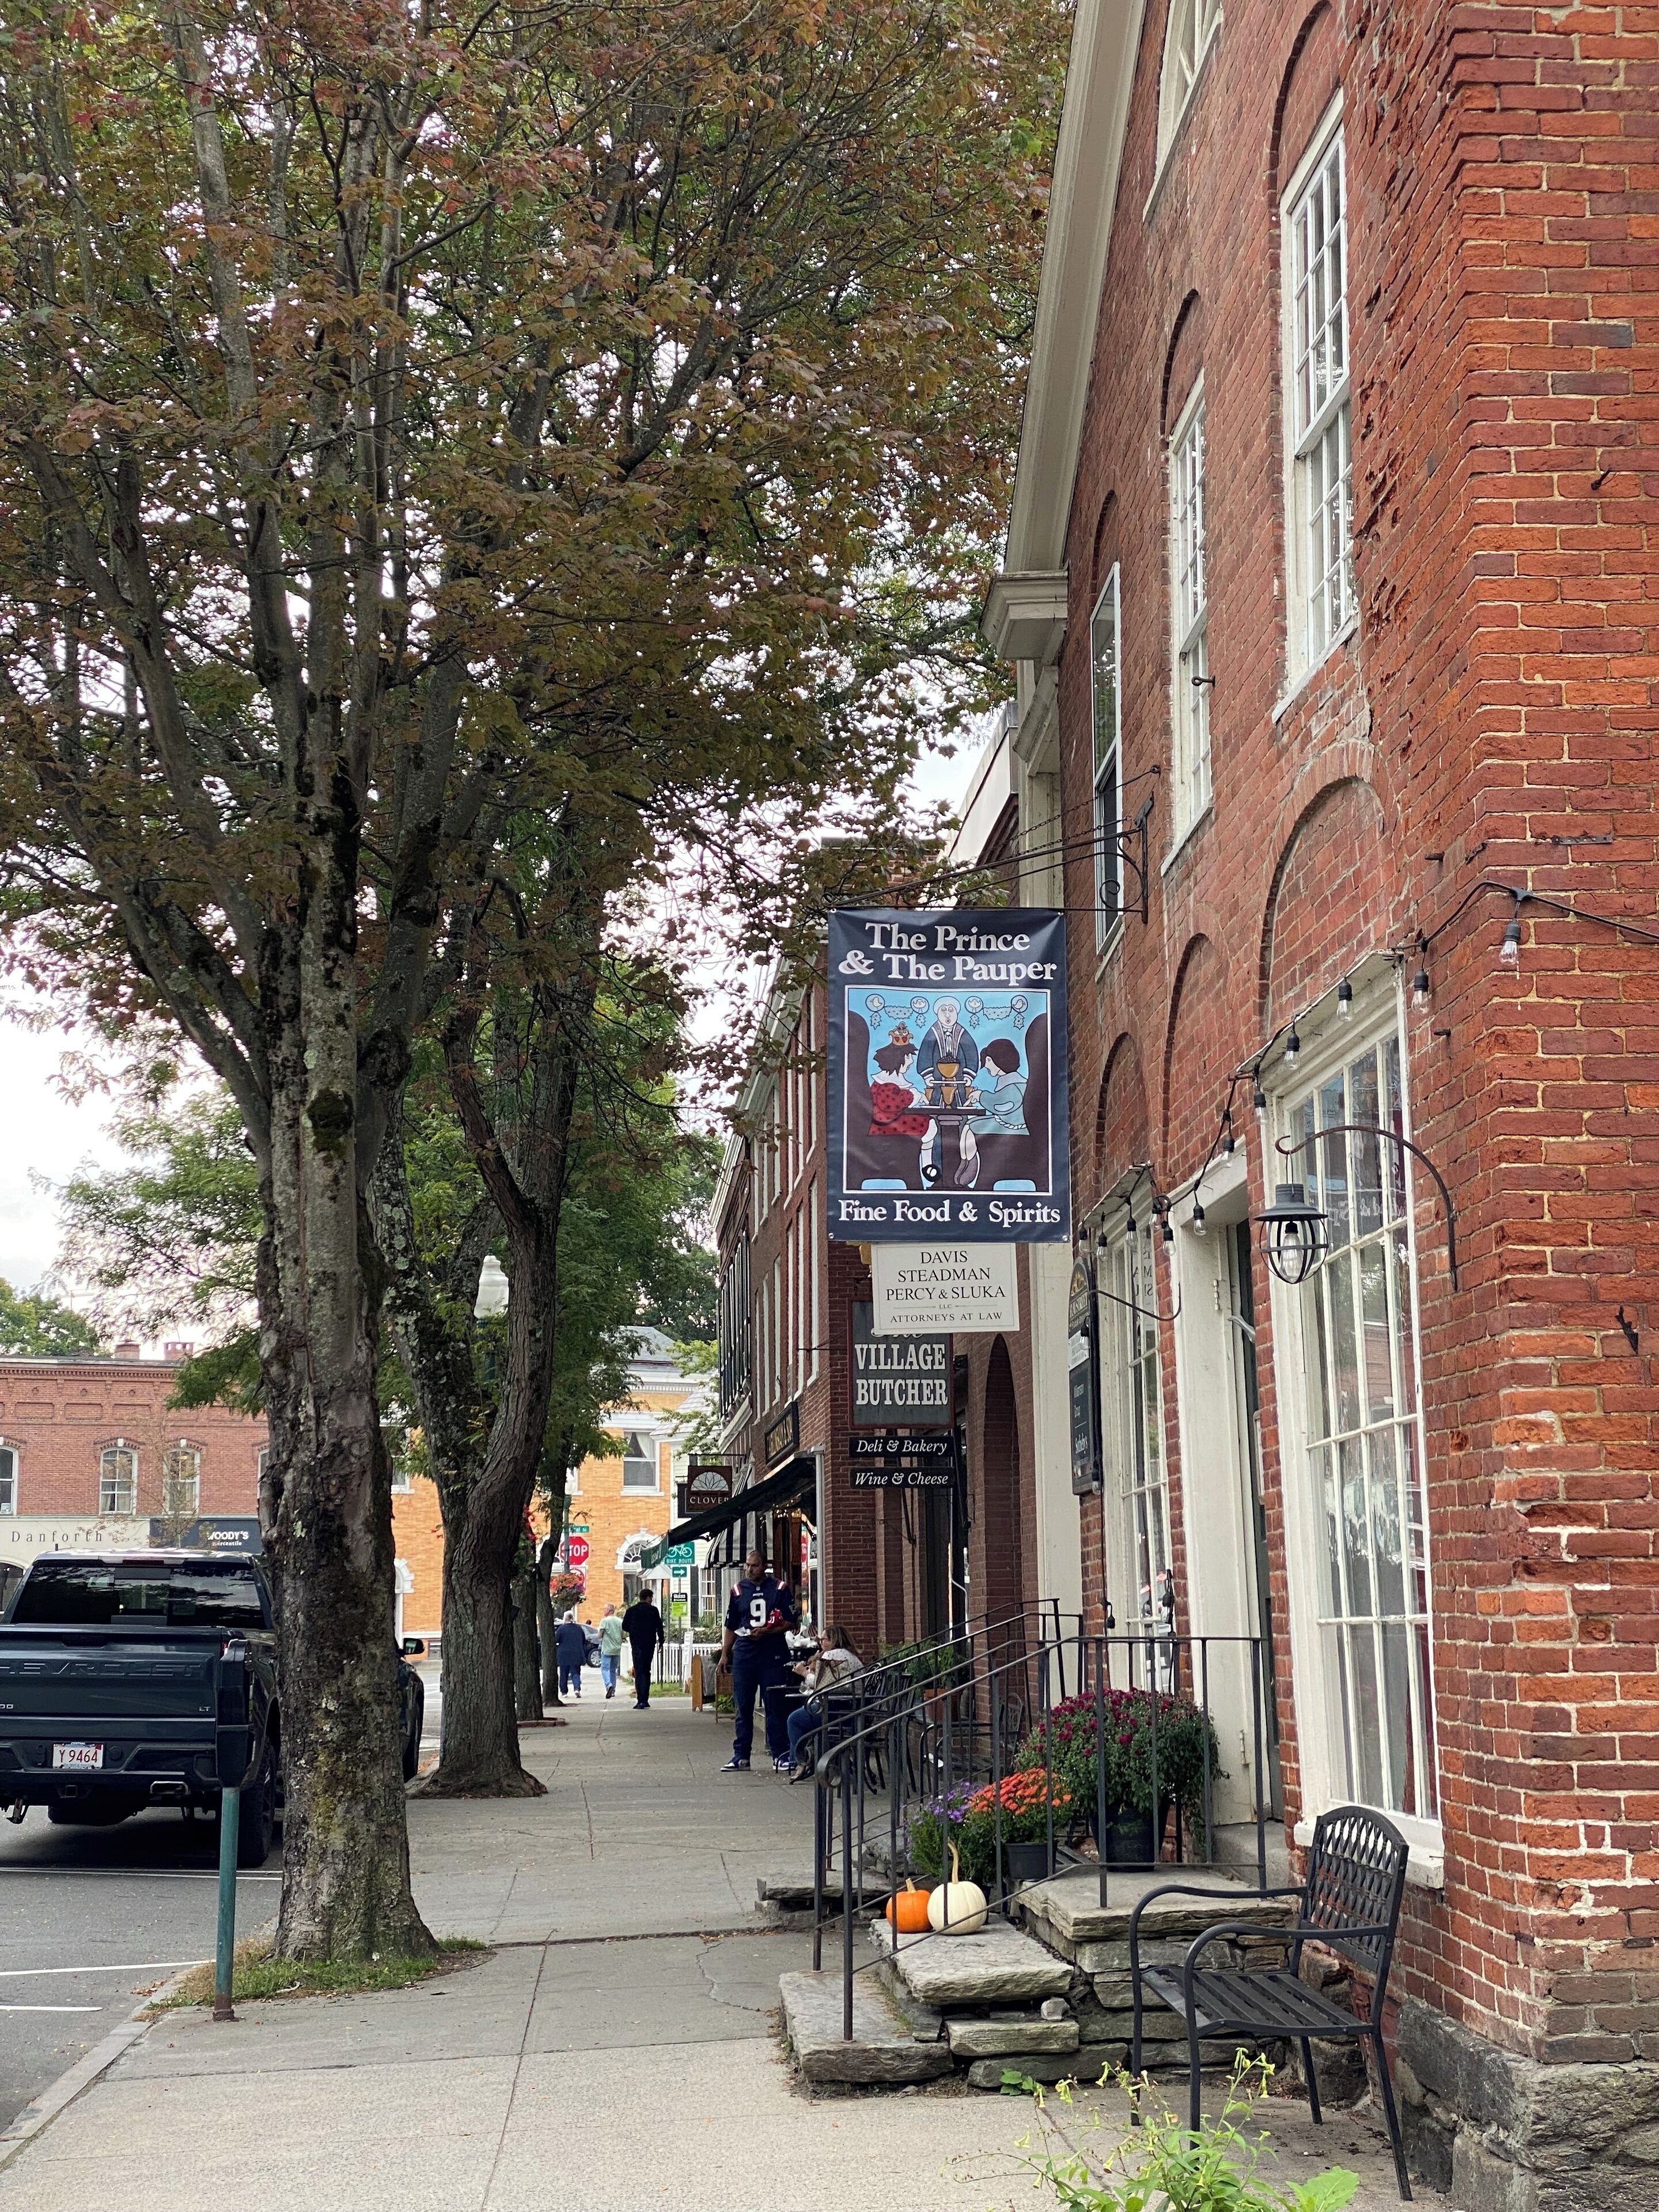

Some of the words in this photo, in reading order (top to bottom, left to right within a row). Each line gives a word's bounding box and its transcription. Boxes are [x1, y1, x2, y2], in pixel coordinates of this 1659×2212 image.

[865, 922, 926, 950] The
[934, 926, 1030, 952] Prince
[839, 950, 874, 975] &
[882, 953, 945, 980] The
[953, 956, 1058, 986] Pauper
[838, 1199, 887, 1222] Fine
[893, 1200, 950, 1222] Food
[959, 1202, 978, 1222] &
[988, 1202, 1060, 1228] Spirits
[921, 1250, 968, 1264] DAVIS
[897, 1267, 991, 1283] STEADMAN
[886, 1287, 935, 1301] PERCY
[938, 1289, 948, 1300] &
[951, 1286, 1006, 1299] SLUKA
[890, 1313, 955, 1323] ATTORNEYS
[960, 1312, 975, 1321] AT
[979, 1312, 1002, 1320] LAW
[854, 1343, 946, 1370] VILLAGE
[856, 1379, 948, 1406] BUTCHER
[857, 1440, 882, 1452] Deli
[887, 1440, 899, 1451] &
[903, 1440, 947, 1455] Bakery
[855, 1473, 888, 1486] Wine
[892, 1473, 904, 1484] &
[908, 1471, 948, 1486] Cheese
[12, 1531, 103, 1542] Danforth
[749, 1599, 766, 1627] 9
[69, 1749, 97, 1763] 9464
